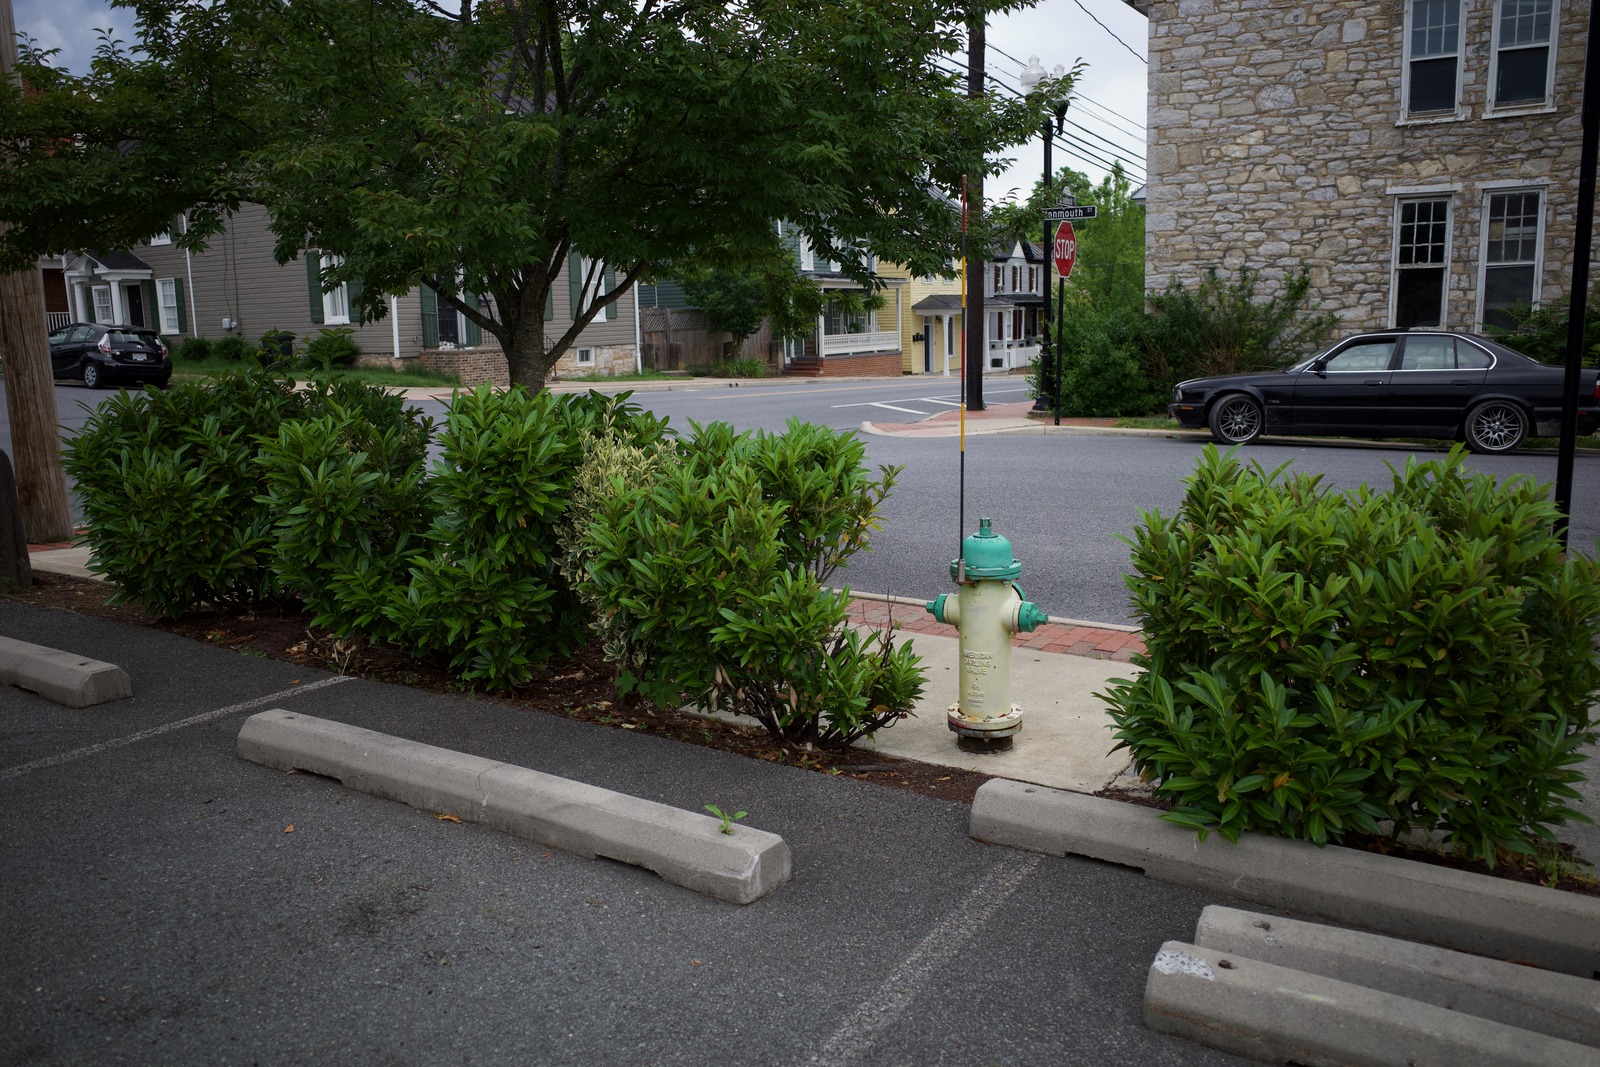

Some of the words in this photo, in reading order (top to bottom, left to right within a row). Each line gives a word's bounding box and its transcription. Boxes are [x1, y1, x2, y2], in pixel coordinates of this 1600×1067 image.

[1042, 209, 1084, 218] onmouth
[1056, 239, 1074, 260] STOP
[964, 649, 992, 660] AMERICAN
[965, 658, 990, 668] DARLING
[966, 666, 987, 675] VALVE
